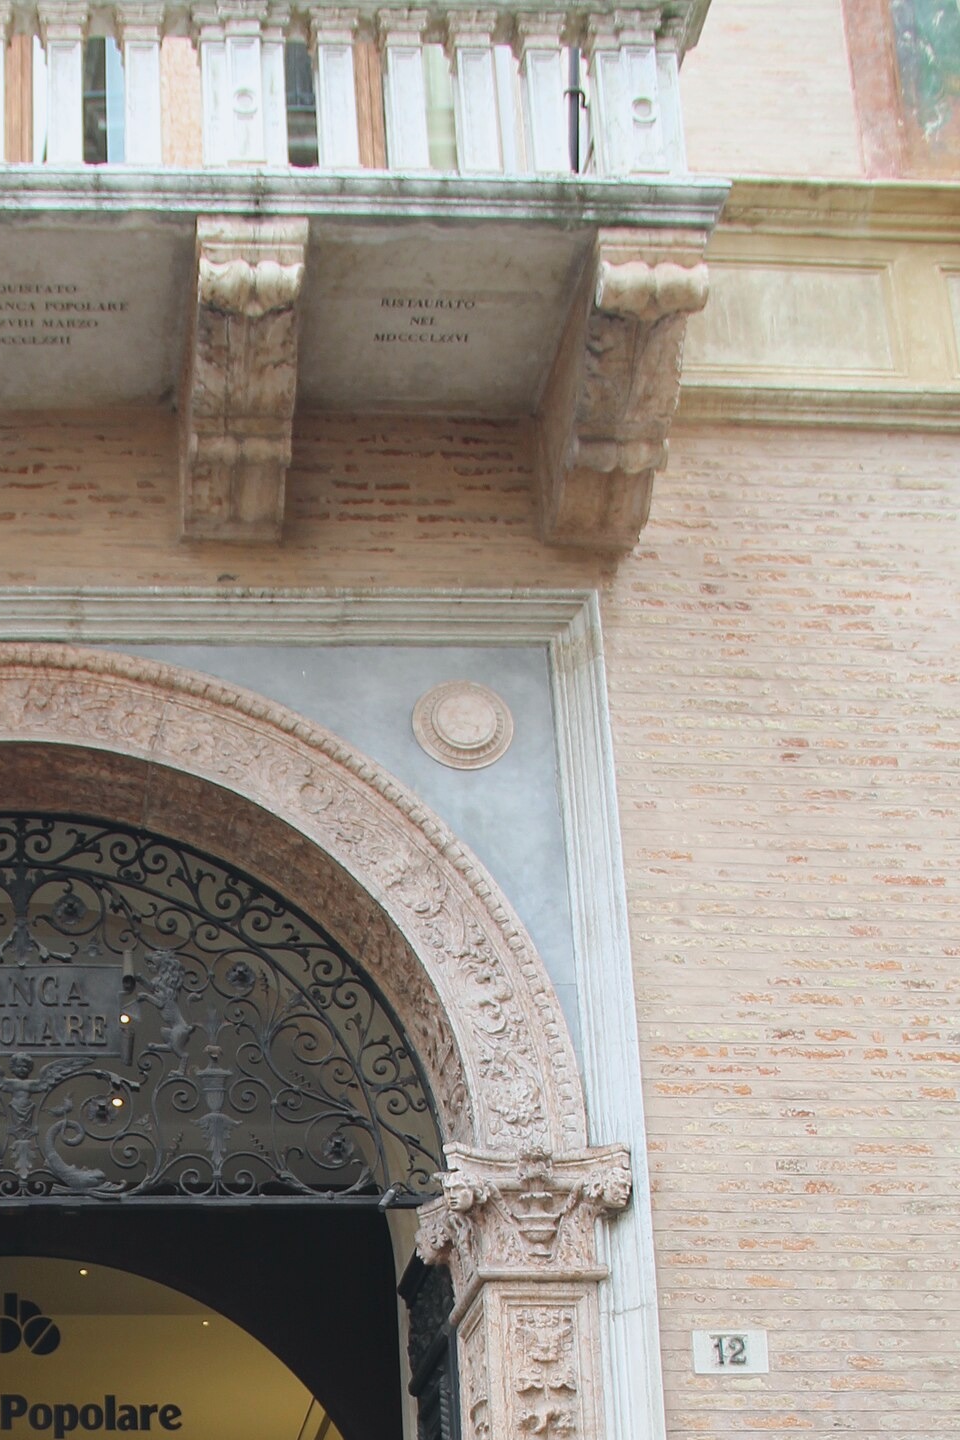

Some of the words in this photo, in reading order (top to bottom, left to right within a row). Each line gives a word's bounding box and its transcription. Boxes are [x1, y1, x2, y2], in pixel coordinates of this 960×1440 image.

[44, 301, 129, 311] POPOLARE
[380, 298, 476, 310] RISTAURATO
[42, 318, 98, 328] MARZO
[409, 316, 435, 326] NEL
[373, 333, 469, 343] MDCCCLXXVI
[713, 1336, 747, 1364] 12
[0, 1393, 183, 1440] Popolare
